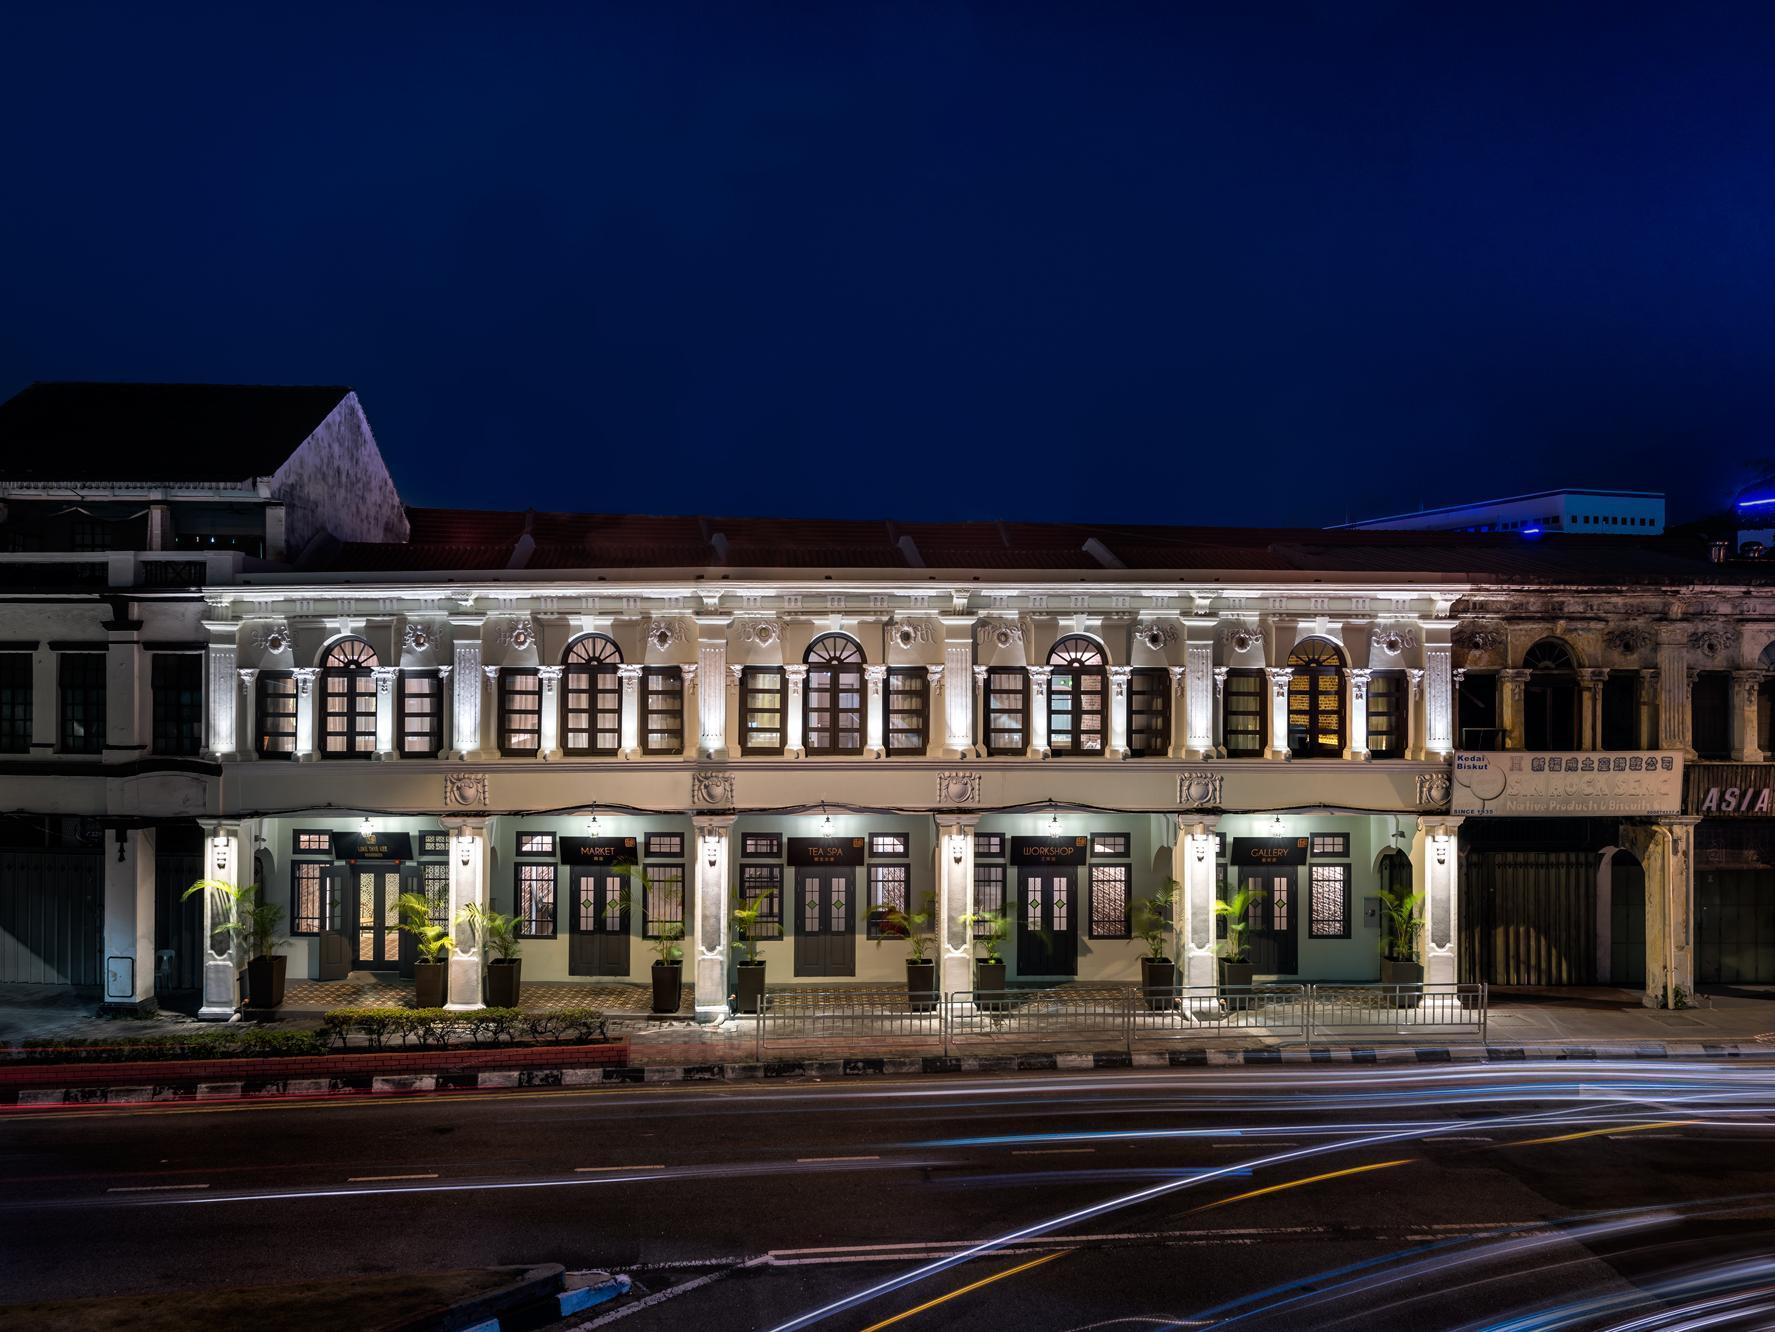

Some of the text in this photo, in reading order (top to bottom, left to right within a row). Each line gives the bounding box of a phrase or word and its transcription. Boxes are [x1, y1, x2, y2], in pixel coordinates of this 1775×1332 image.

[1702, 787, 1770, 812] ASIA
[1506, 800, 1546, 811] Native
[1550, 800, 1597, 811] Products
[581, 847, 615, 856] MARKET
[808, 847, 843, 856] TEA SPA
[1023, 846, 1074, 856] WORKSHOP
[1251, 848, 1289, 857] GALLERY
